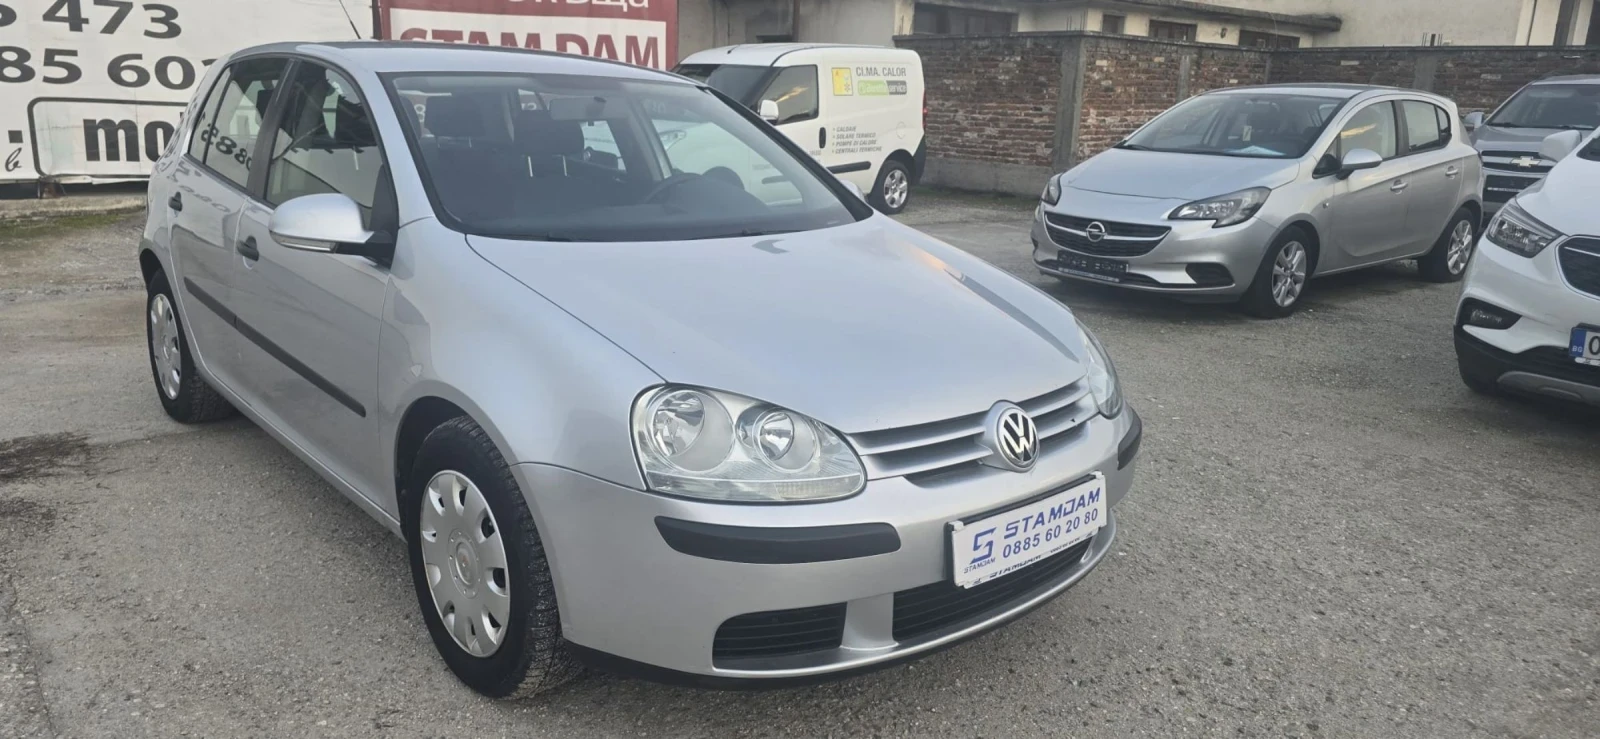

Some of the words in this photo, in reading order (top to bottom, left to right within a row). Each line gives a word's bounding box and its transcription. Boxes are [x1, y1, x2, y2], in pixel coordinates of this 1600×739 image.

[42, 0, 181, 39] 473
[882, 67, 907, 77] CALOR
[1002, 531, 1041, 559] 0885
[1045, 525, 1061, 542] 60
[1066, 516, 1080, 534] 20
[1084, 508, 1099, 525] 80
